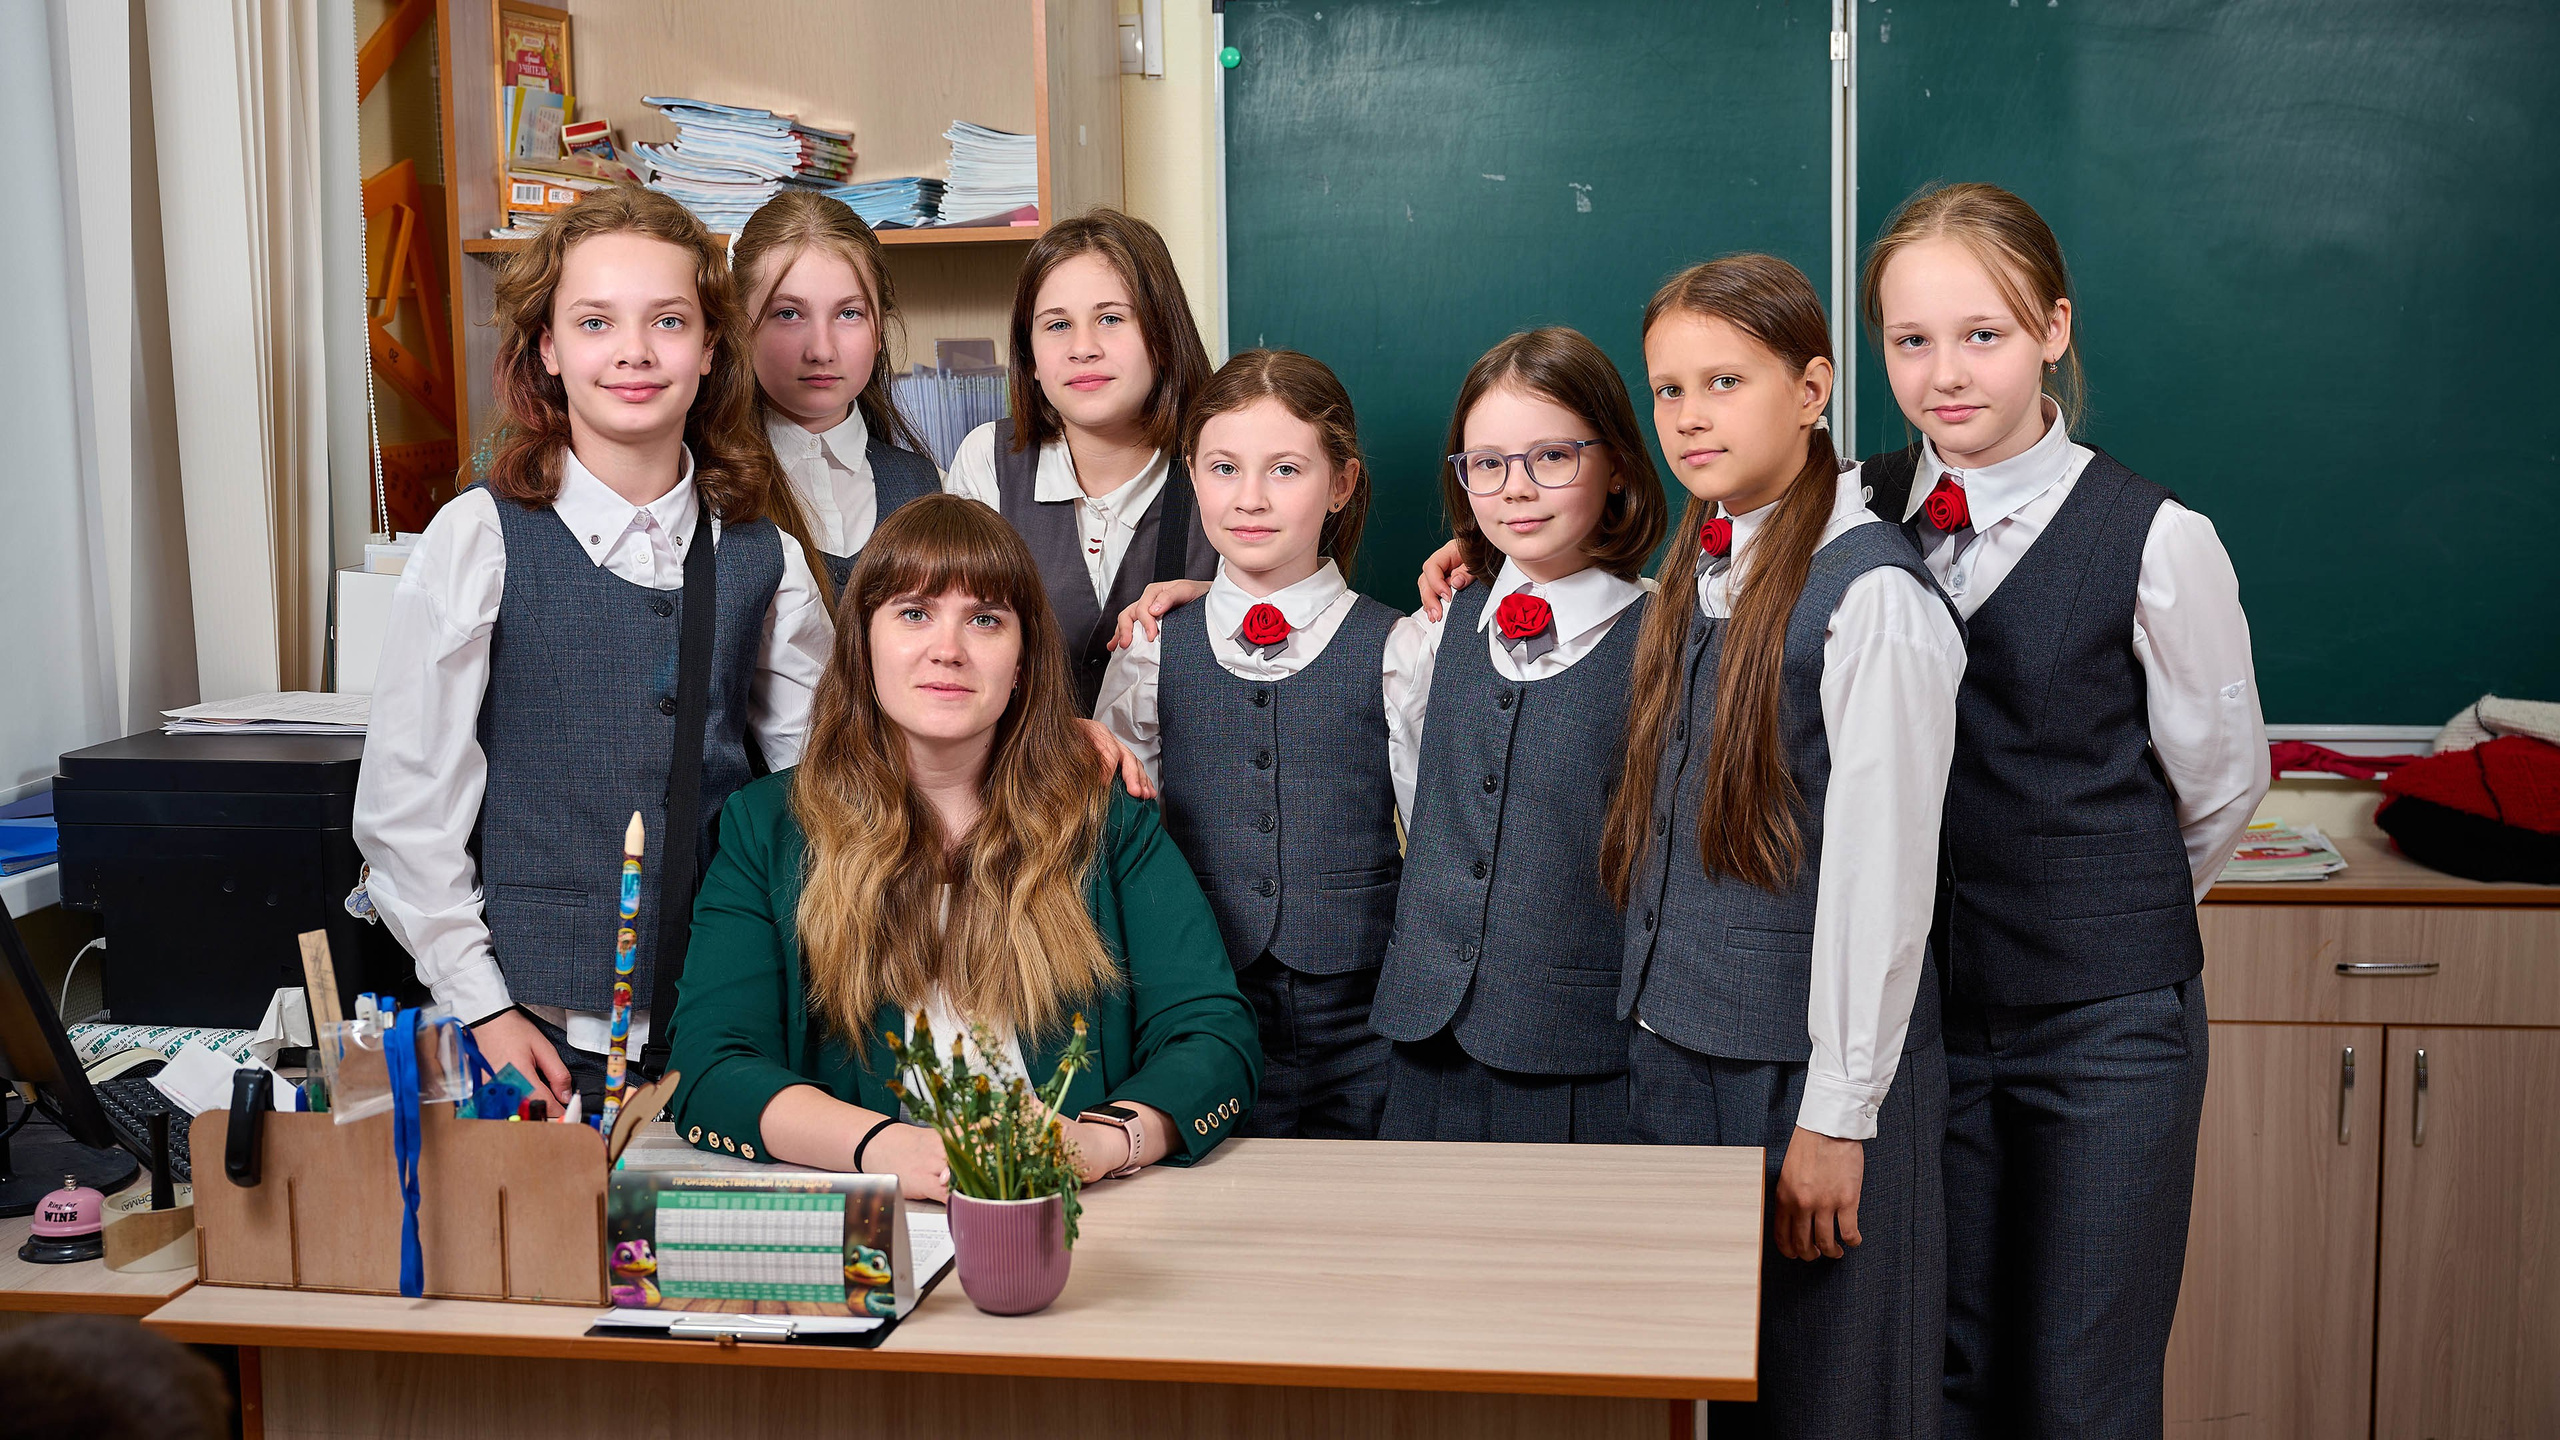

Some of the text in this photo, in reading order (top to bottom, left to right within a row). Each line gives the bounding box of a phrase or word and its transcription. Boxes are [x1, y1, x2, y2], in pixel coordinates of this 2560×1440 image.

[518, 64, 548, 76] УЧИТЕЛЬ
[672, 1177, 833, 1190] ПРОИЗВОДСТВЕННЫЙ КАЛЕНДАРЬ
[48, 1202, 78, 1210] Ring for
[44, 1211, 78, 1222] WINE
